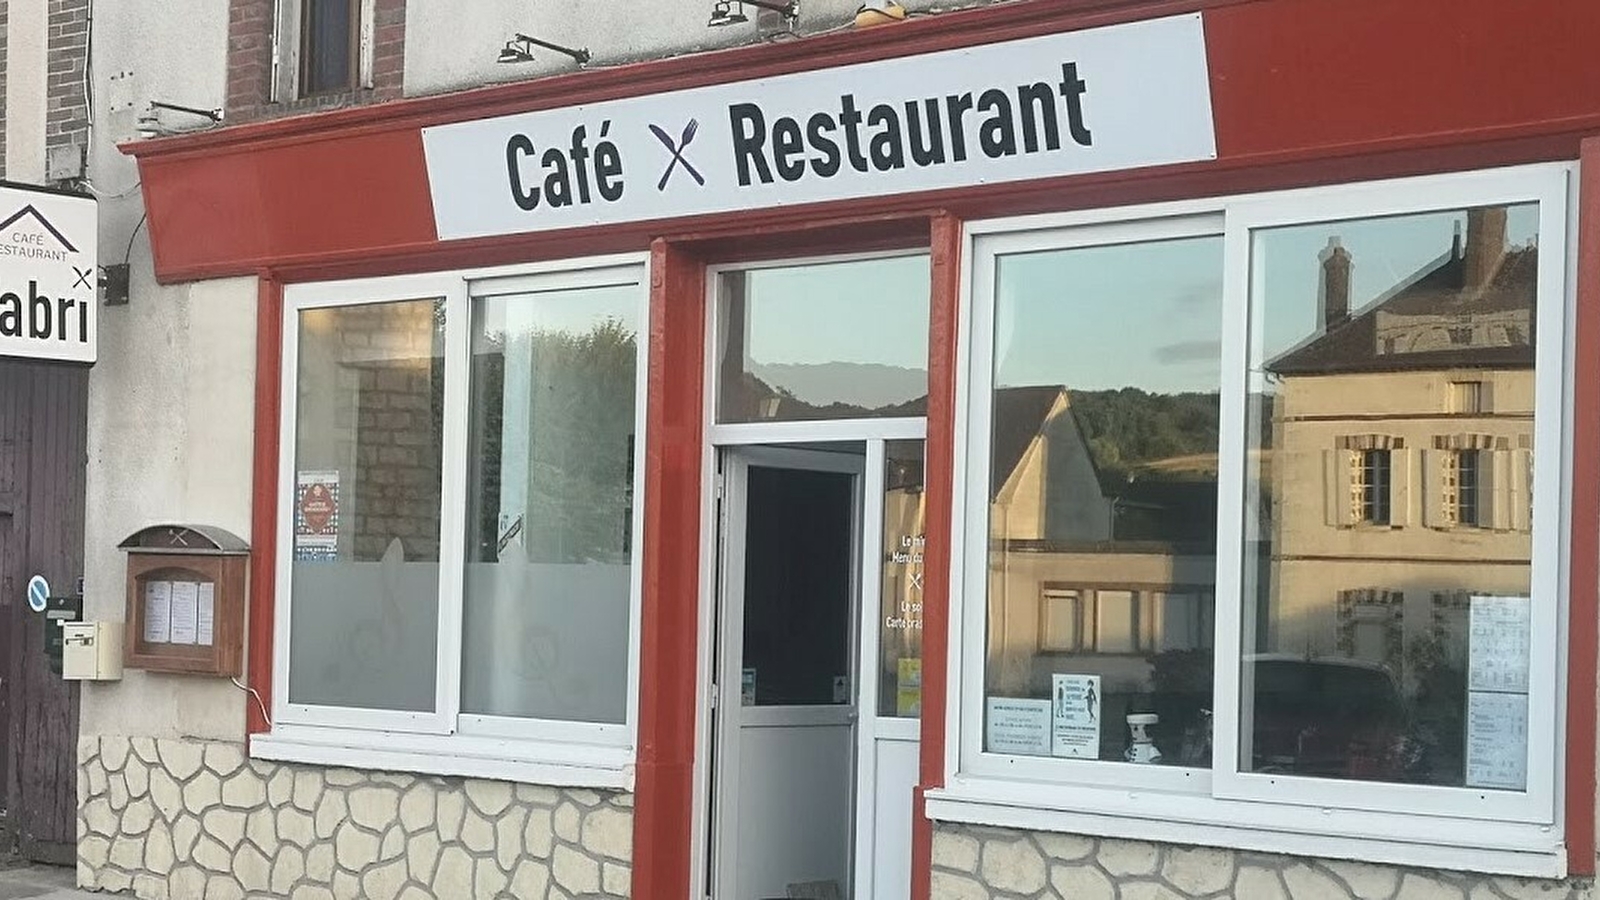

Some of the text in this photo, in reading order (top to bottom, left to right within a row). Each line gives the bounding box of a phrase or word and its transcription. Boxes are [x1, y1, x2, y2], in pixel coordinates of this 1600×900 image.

[505, 61, 1093, 211] Café Restaurant
[12, 231, 44, 246] CAFÉ
[0, 280, 88, 343] abri
